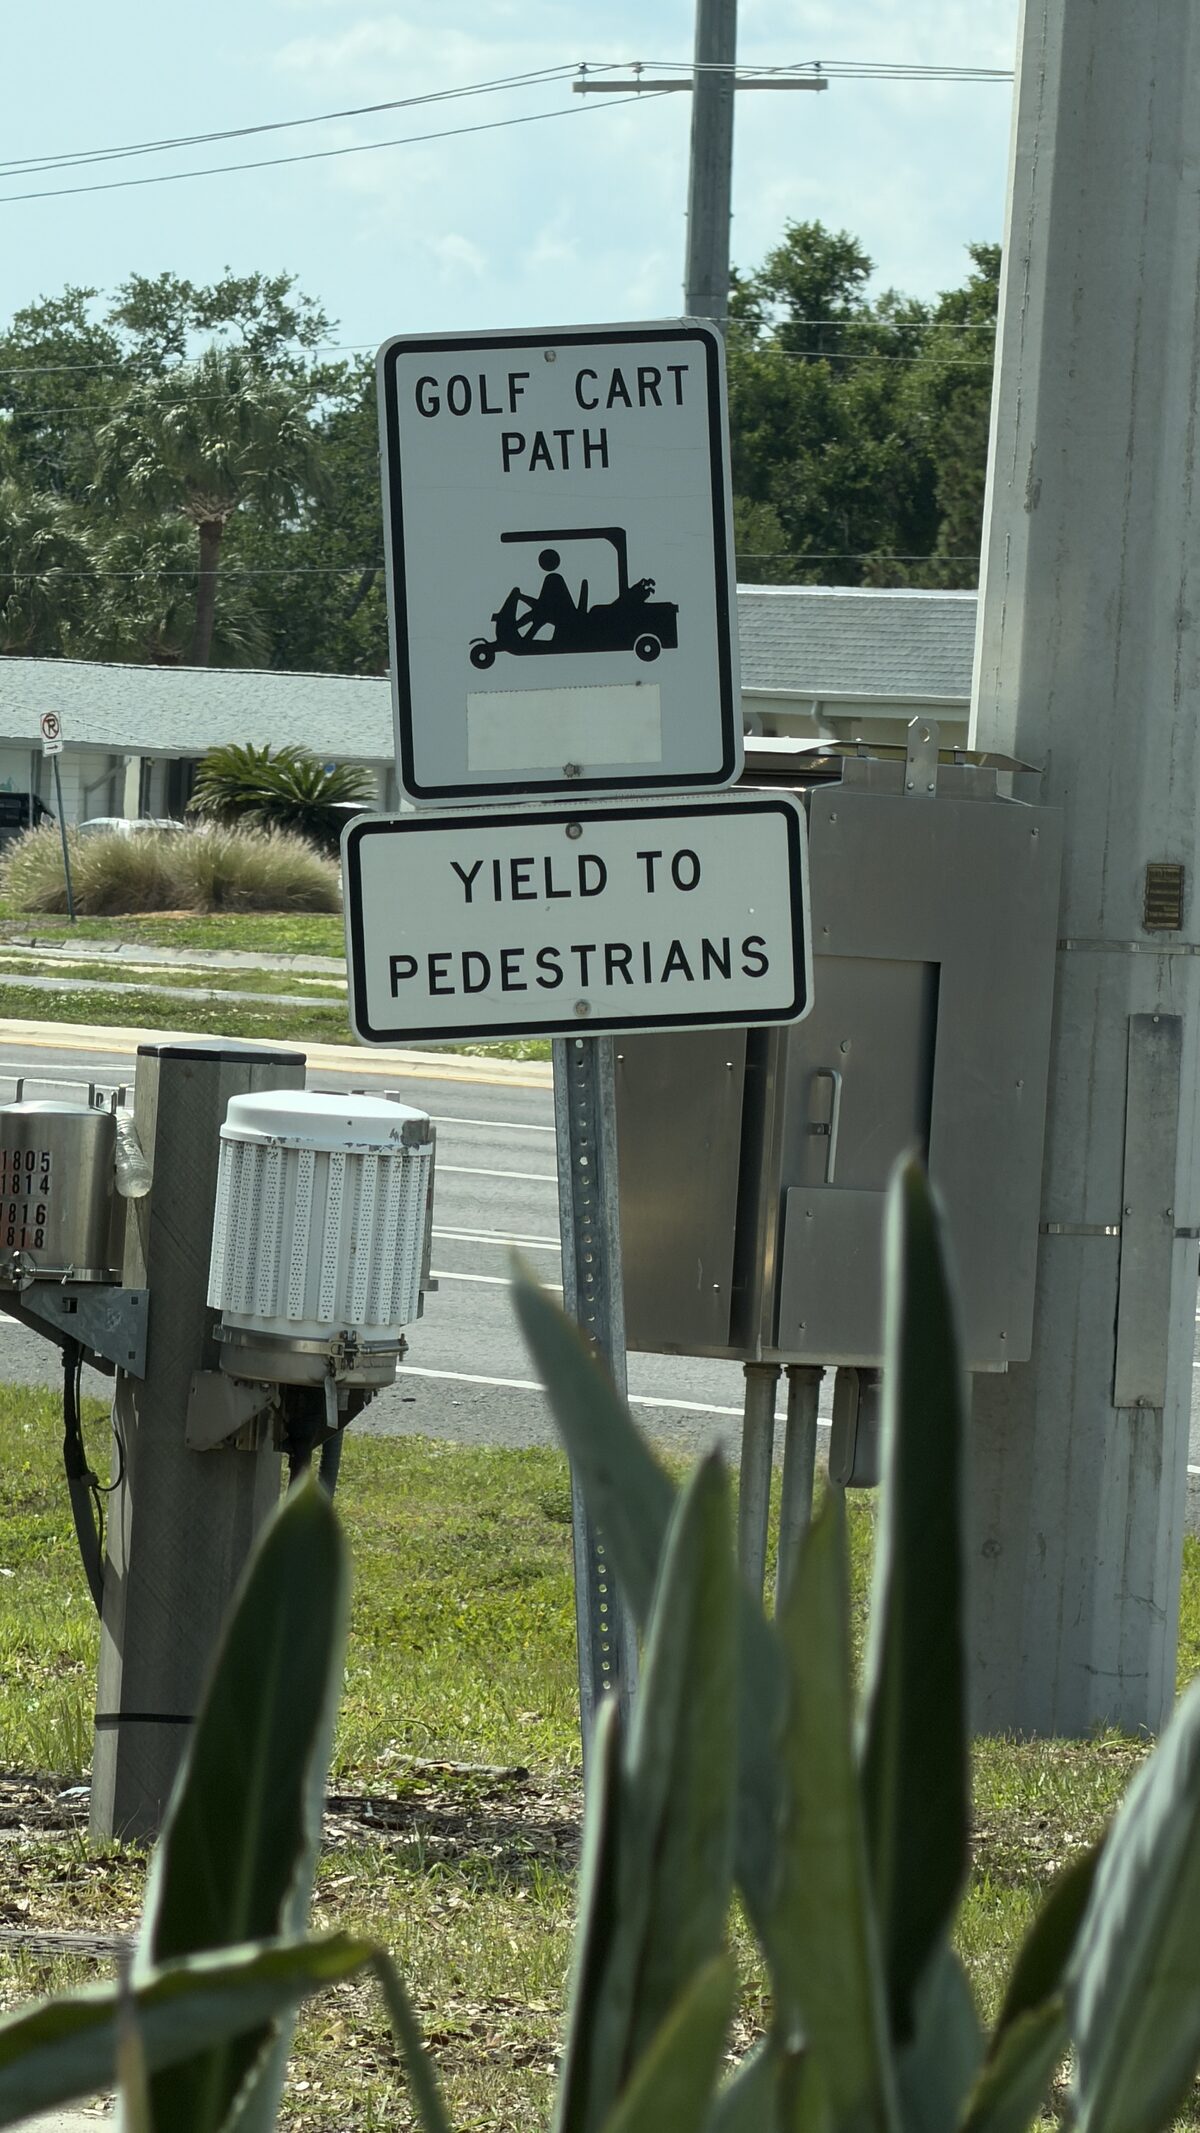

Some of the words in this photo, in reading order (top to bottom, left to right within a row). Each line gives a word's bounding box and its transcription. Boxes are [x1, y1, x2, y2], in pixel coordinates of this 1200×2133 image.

[415, 372, 530, 418] GOLF
[575, 365, 689, 410] CART
[501, 428, 610, 473] PATH
[450, 854, 608, 903] YIELD
[636, 849, 701, 893] TO
[389, 935, 770, 998] PEDESTRIANS
[1, 1173, 50, 1195] 1814
[2, 1150, 50, 1173] 1805
